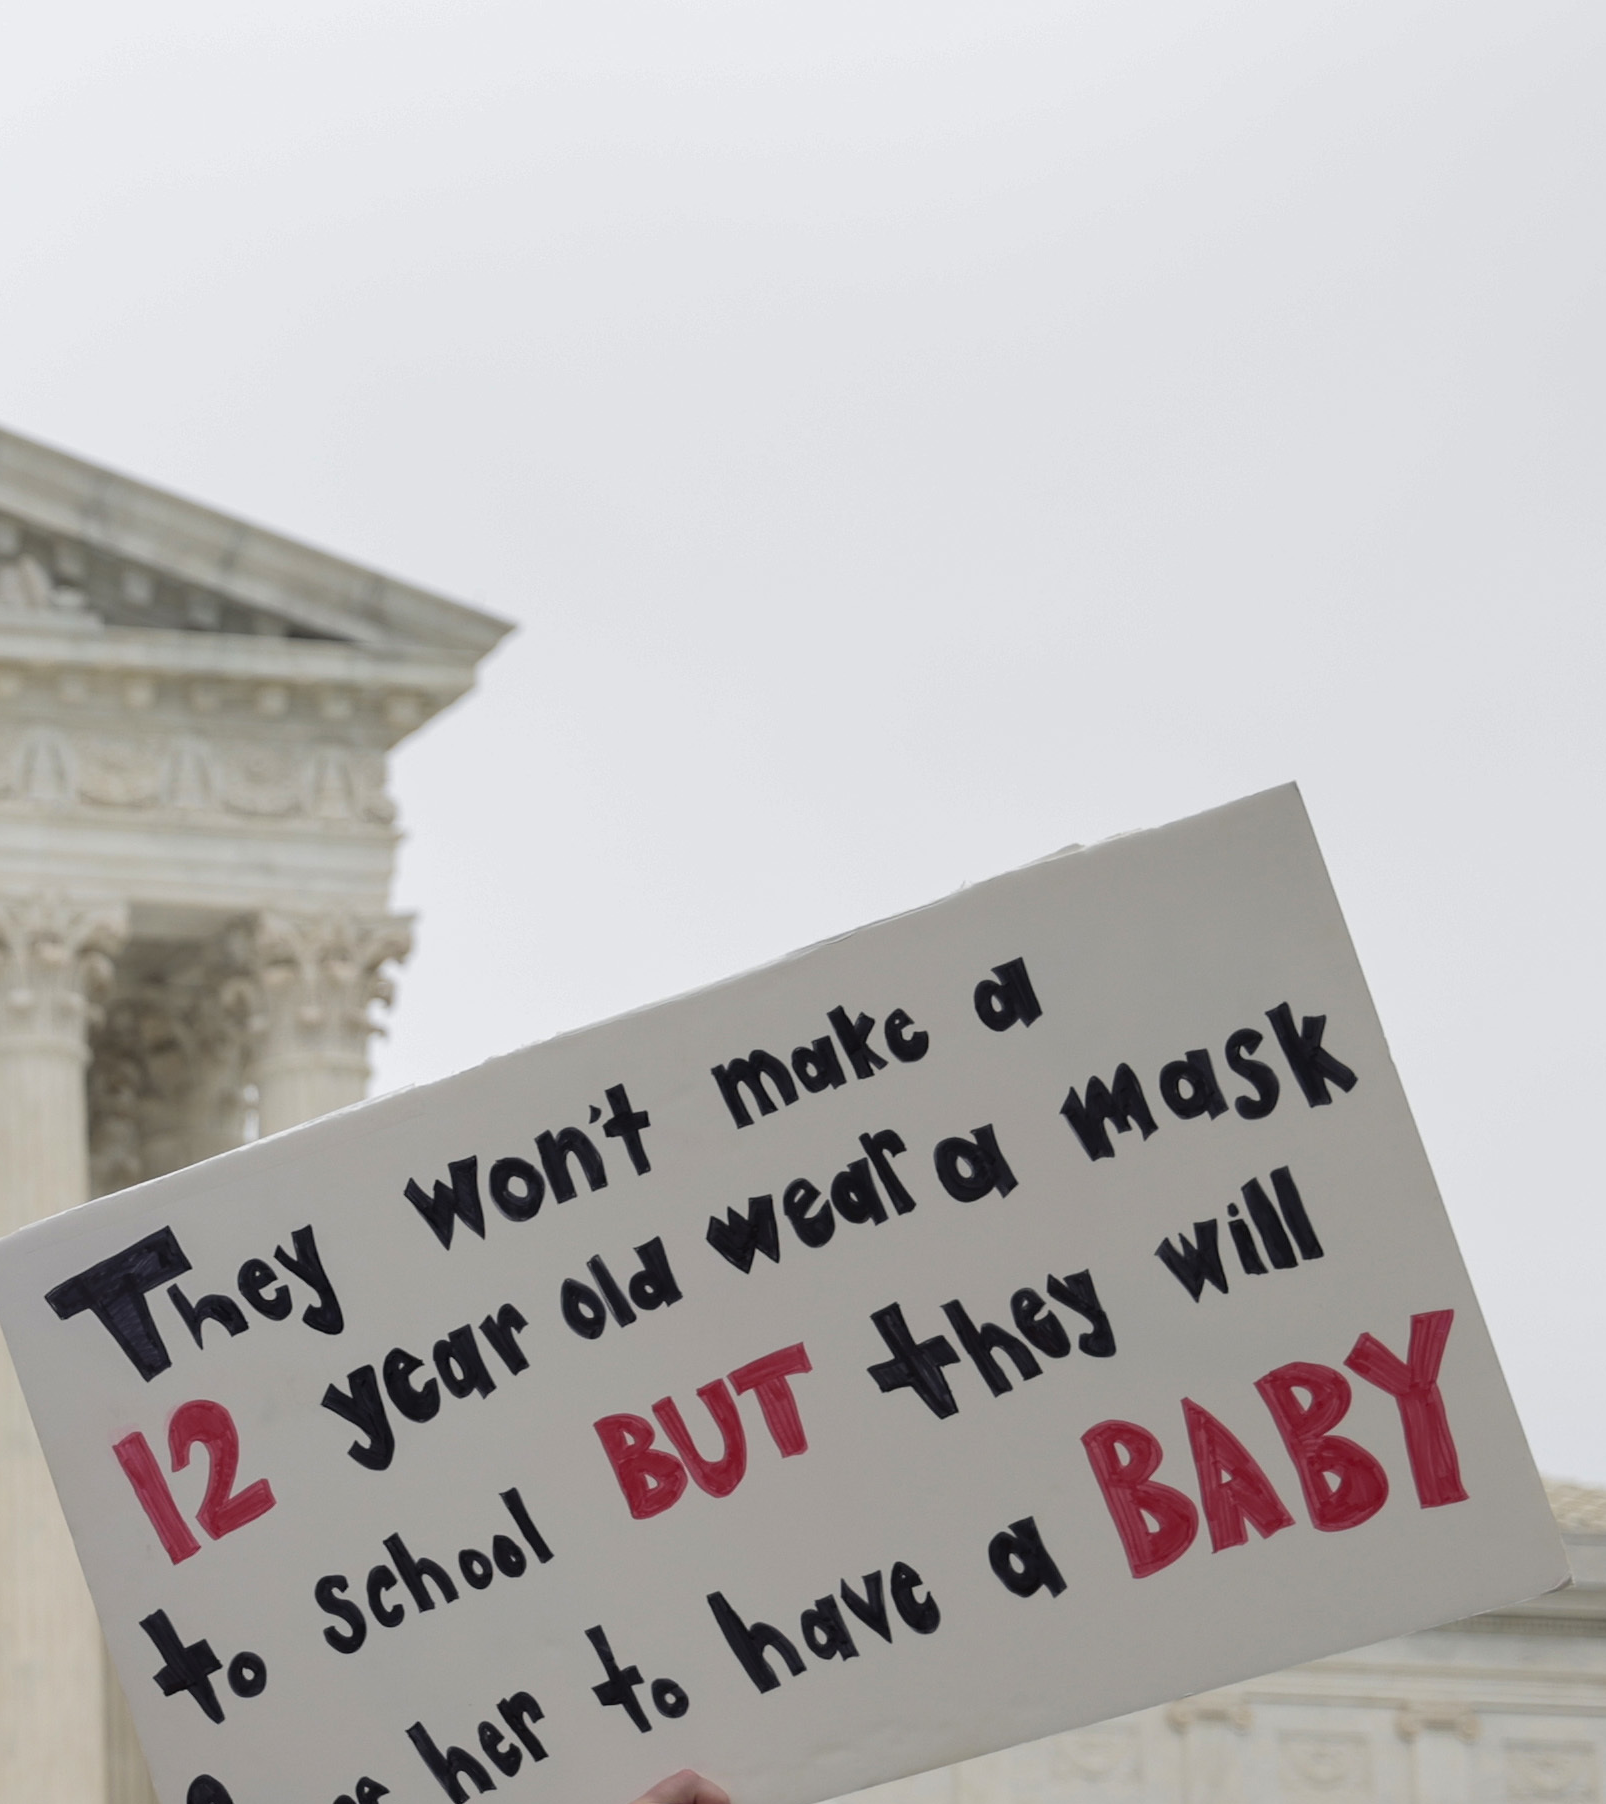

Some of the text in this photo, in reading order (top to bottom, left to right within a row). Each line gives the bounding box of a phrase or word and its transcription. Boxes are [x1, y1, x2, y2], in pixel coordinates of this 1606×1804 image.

[44, 1224, 345, 1383] They
[711, 1004, 930, 1129] make
[973, 956, 1044, 1033] a
[111, 1397, 278, 1566] 12
[320, 1301, 529, 1472] year
[560, 1235, 682, 1340] old
[932, 1122, 1019, 1204] a
[1058, 1001, 1360, 1162] mask
[137, 1607, 268, 1725] to
[592, 1340, 813, 1522] BUT
[867, 1268, 1118, 1421] they
[584, 1624, 691, 1734] to
[706, 1560, 943, 1695] have
[987, 1514, 1069, 1599] a
[1079, 1308, 1471, 1580] BABY
